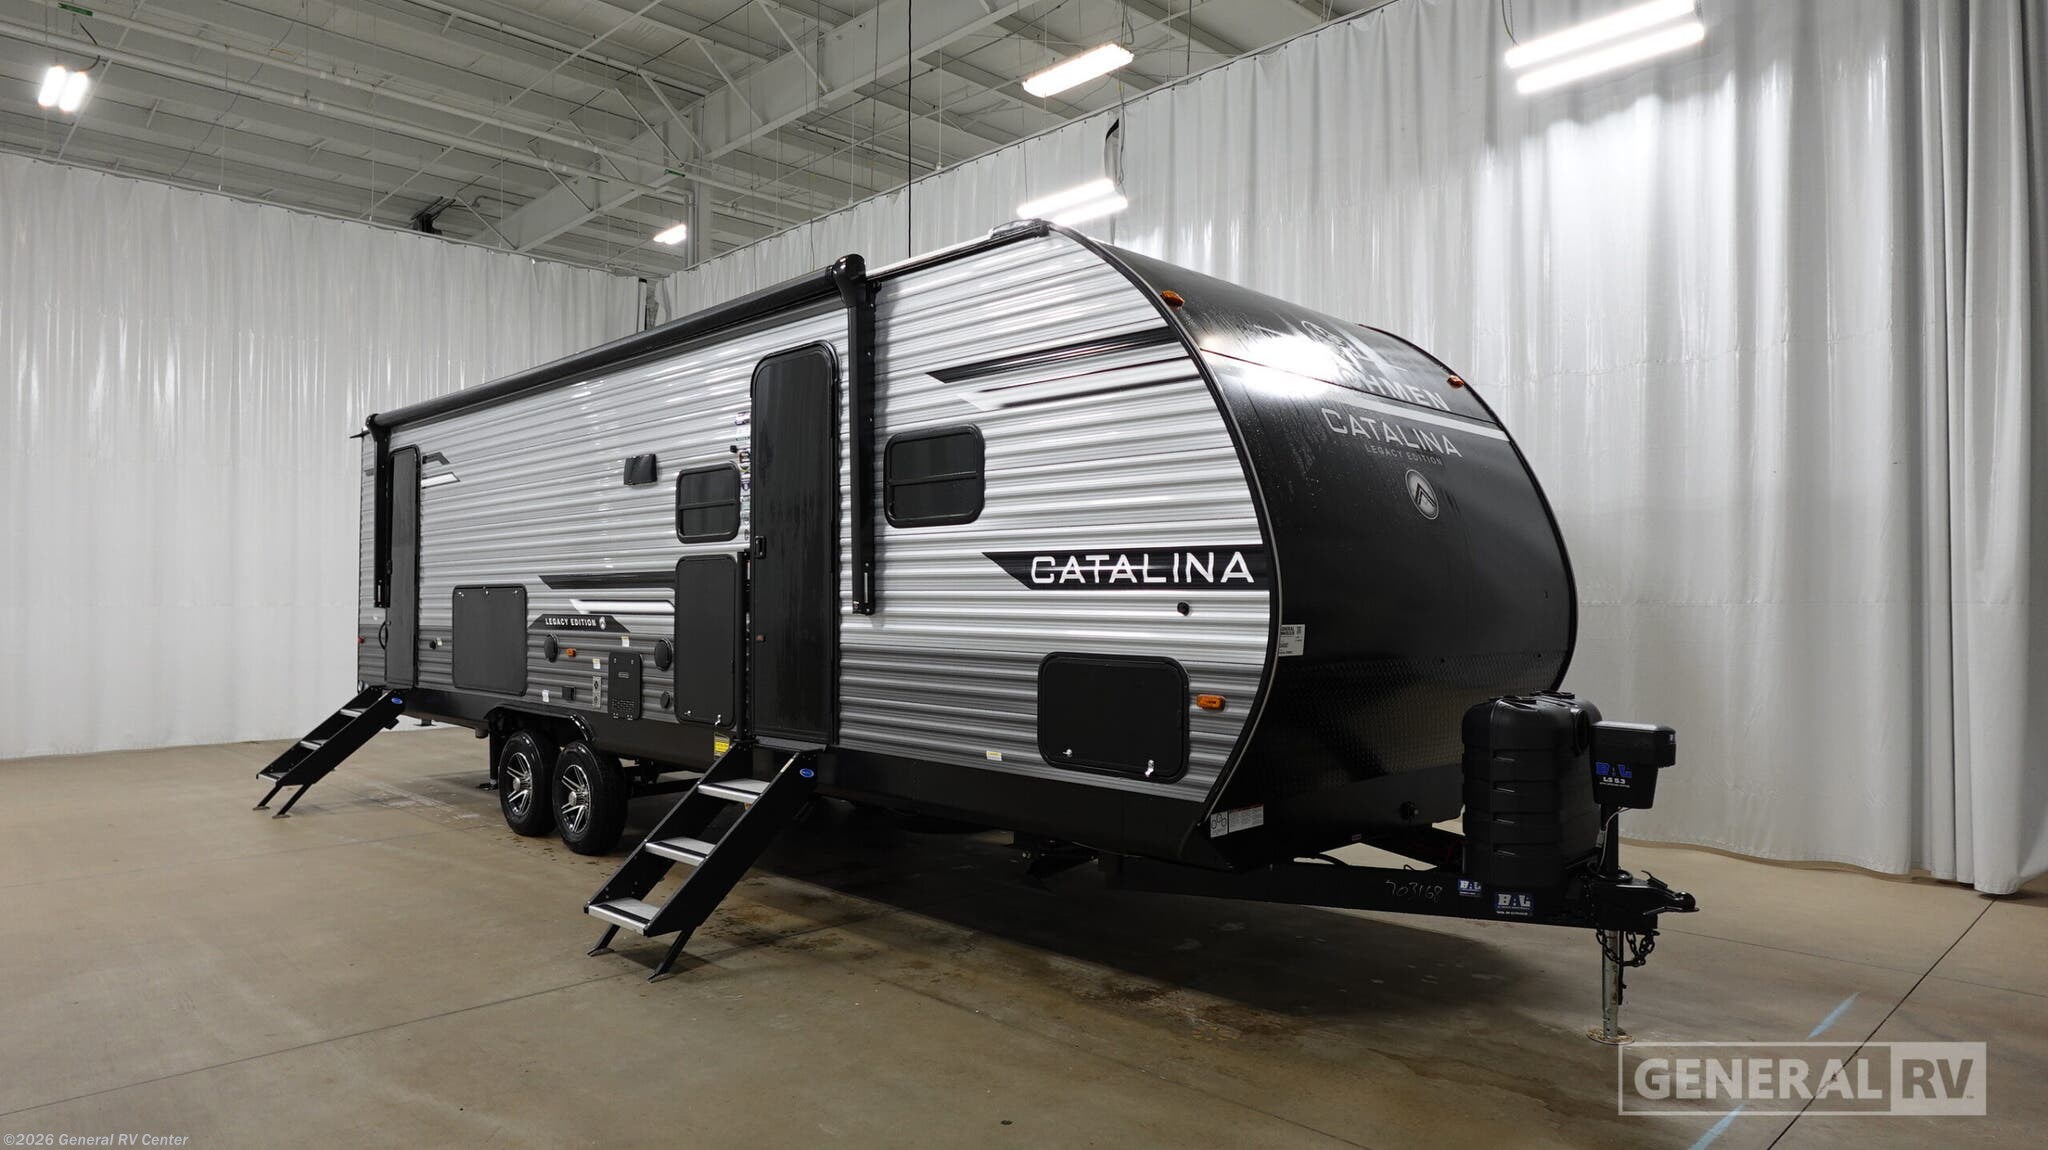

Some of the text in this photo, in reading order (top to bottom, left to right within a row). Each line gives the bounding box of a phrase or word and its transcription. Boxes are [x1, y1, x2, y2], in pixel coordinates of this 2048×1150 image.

[1321, 408, 1463, 457] CATALINA
[1365, 444, 1443, 466] LEGACY EDITION
[1030, 551, 1255, 584] CATALINA
[545, 617, 597, 627] LEGACY EDITION
